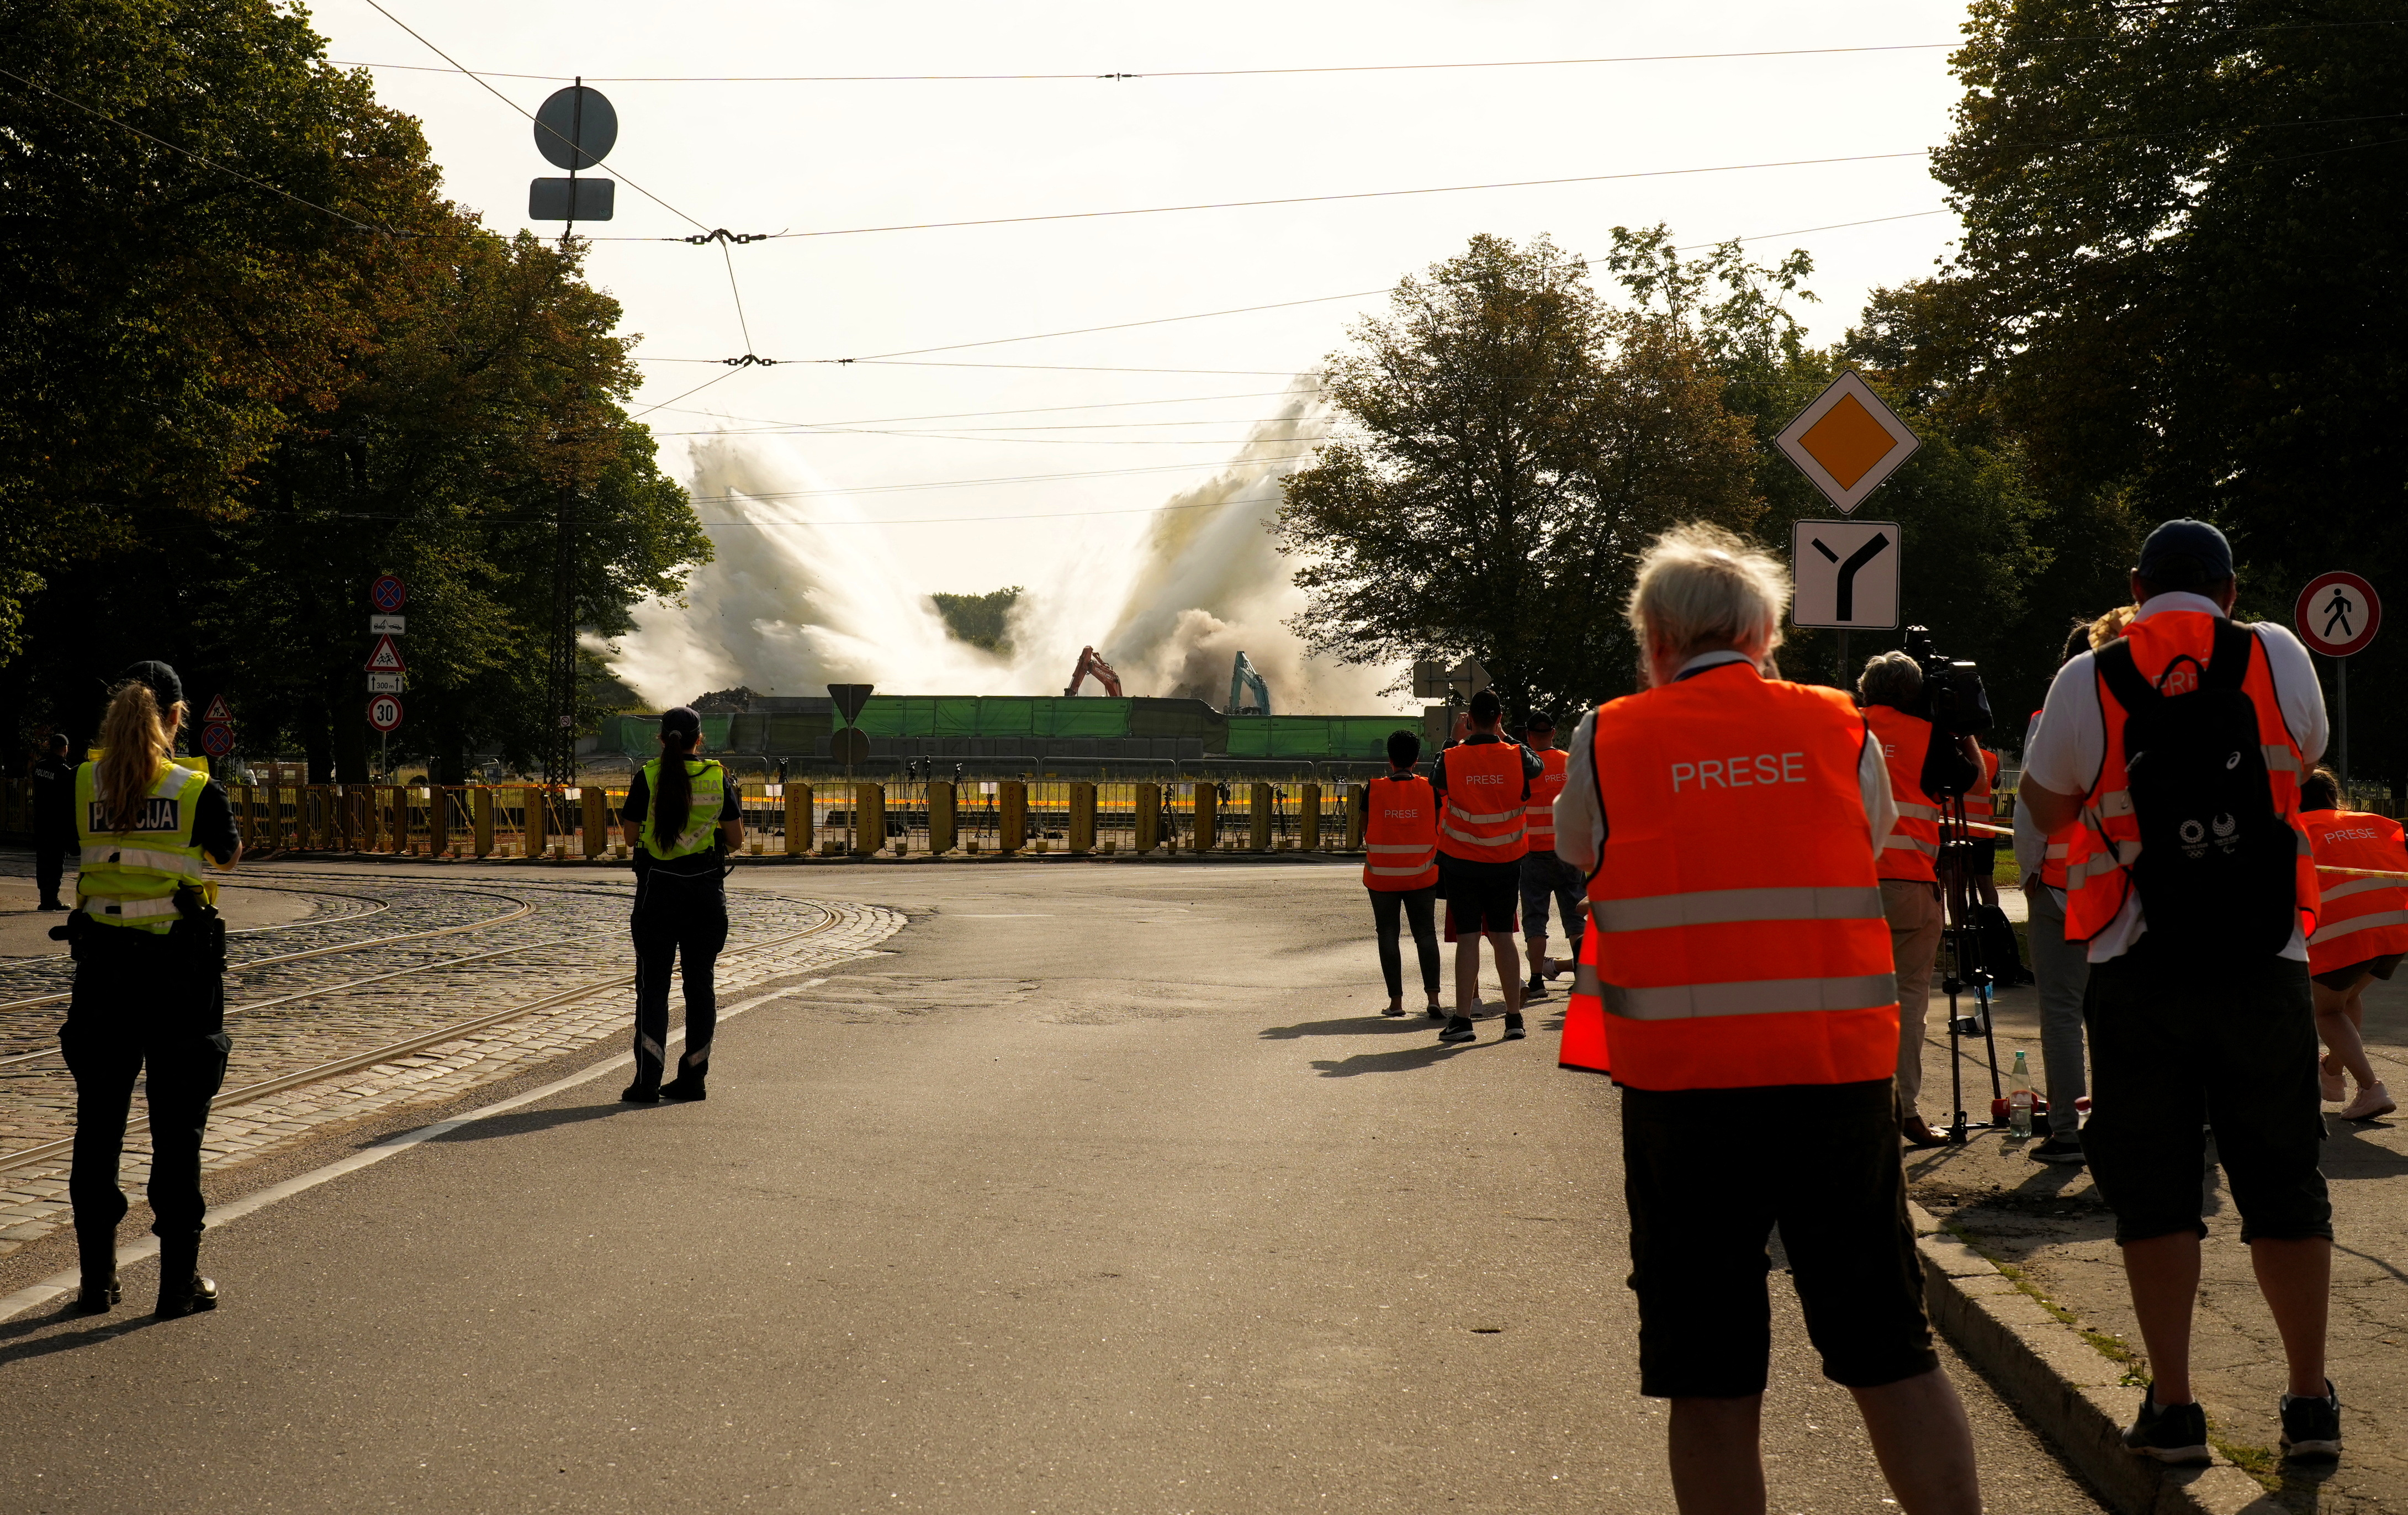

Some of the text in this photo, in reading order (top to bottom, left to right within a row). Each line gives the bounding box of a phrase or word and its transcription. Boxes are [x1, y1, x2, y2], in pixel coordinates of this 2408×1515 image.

[377, 705, 393, 721] 30
[34, 768, 55, 781] POLICIJA
[1544, 773, 1568, 783] PRES
[1671, 752, 1806, 793] PRESE
[1466, 774, 1504, 785] PRESE
[1384, 809, 1418, 819] PRESE
[2325, 827, 2378, 844] PRESE
